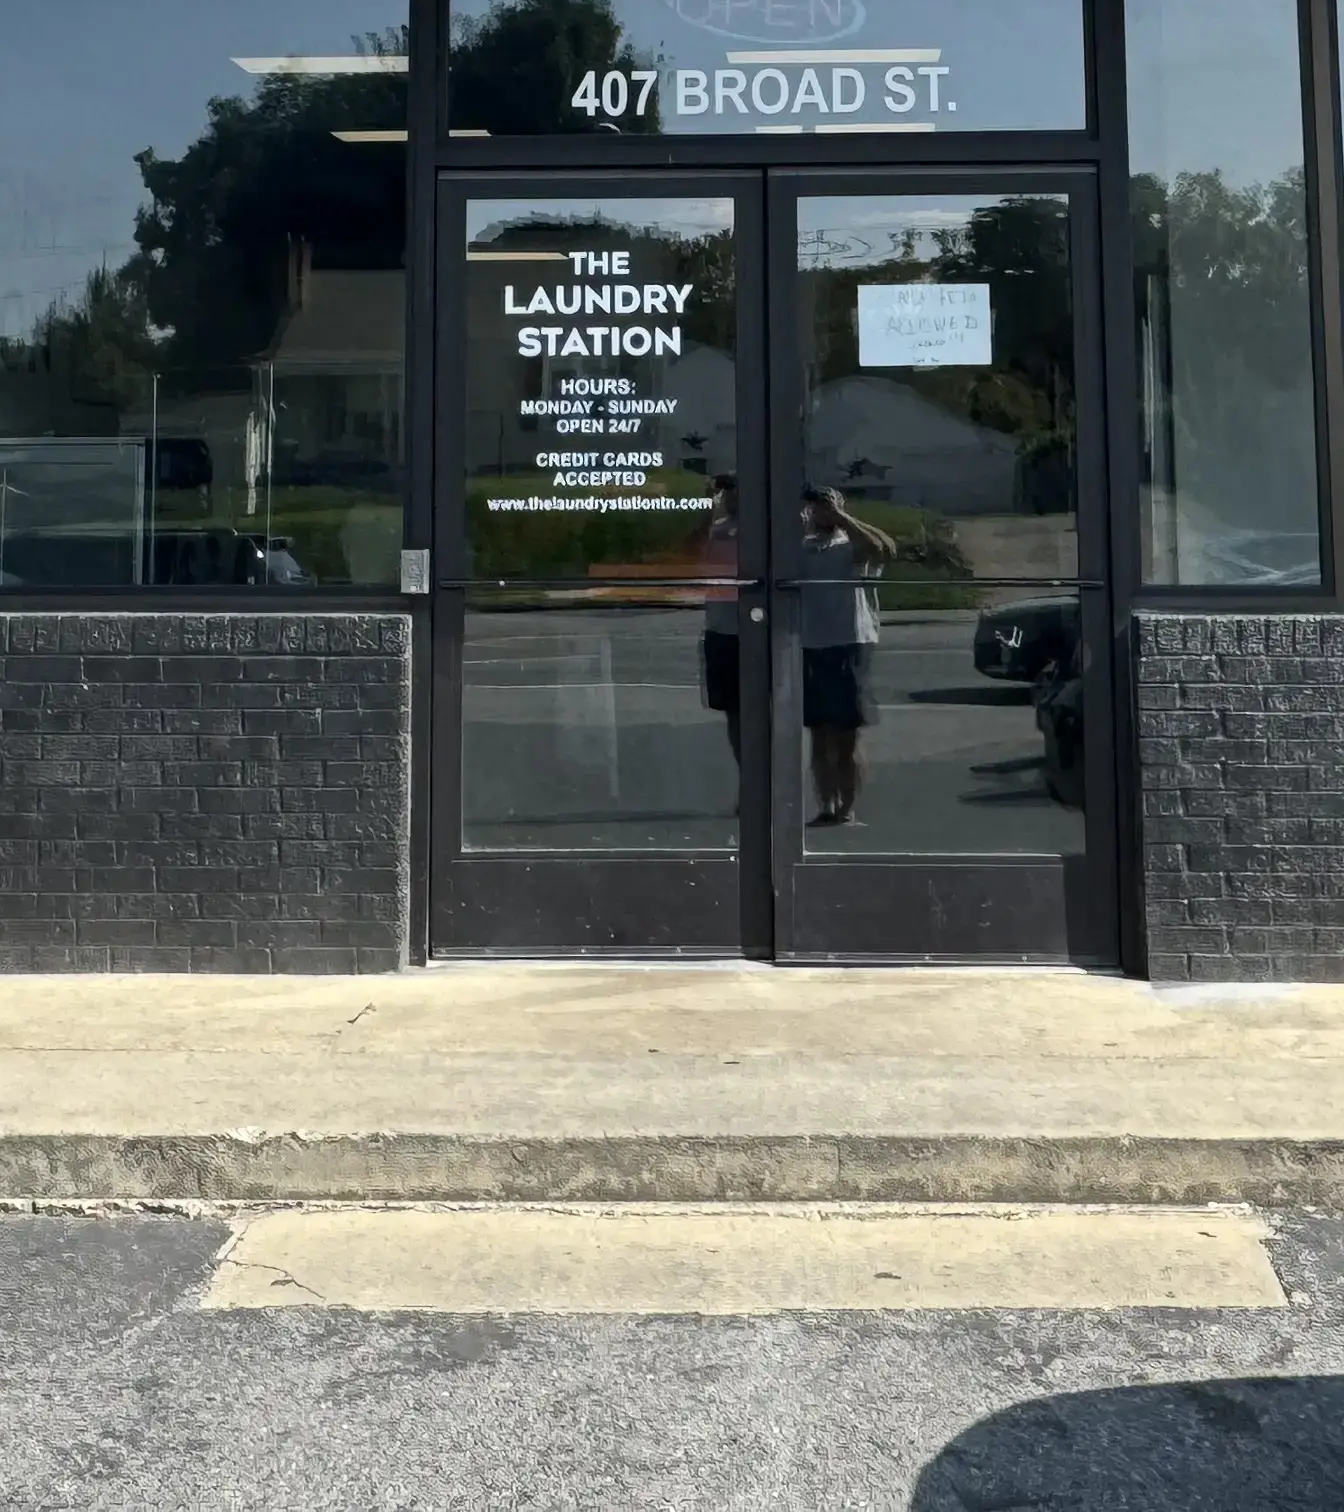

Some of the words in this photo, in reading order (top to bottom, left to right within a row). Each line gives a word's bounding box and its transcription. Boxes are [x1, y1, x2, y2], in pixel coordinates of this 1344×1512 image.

[571, 69, 658, 117] 407
[676, 66, 867, 115] BROAD
[883, 65, 957, 113] ST.
[568, 251, 631, 276] THE
[504, 284, 694, 315] LAUNDRY
[517, 326, 682, 358] STATION
[560, 378, 637, 395] HOURS:
[520, 399, 595, 415] MONDAY
[607, 399, 678, 414] SUNDAY
[556, 419, 604, 434] OPEN
[608, 419, 642, 434] 24/7
[535, 452, 599, 467] CREDIT
[602, 452, 664, 468] CARDS
[552, 471, 647, 487] ACCEPTED
[486, 494, 713, 513] www.thelaundrystationtn.com
